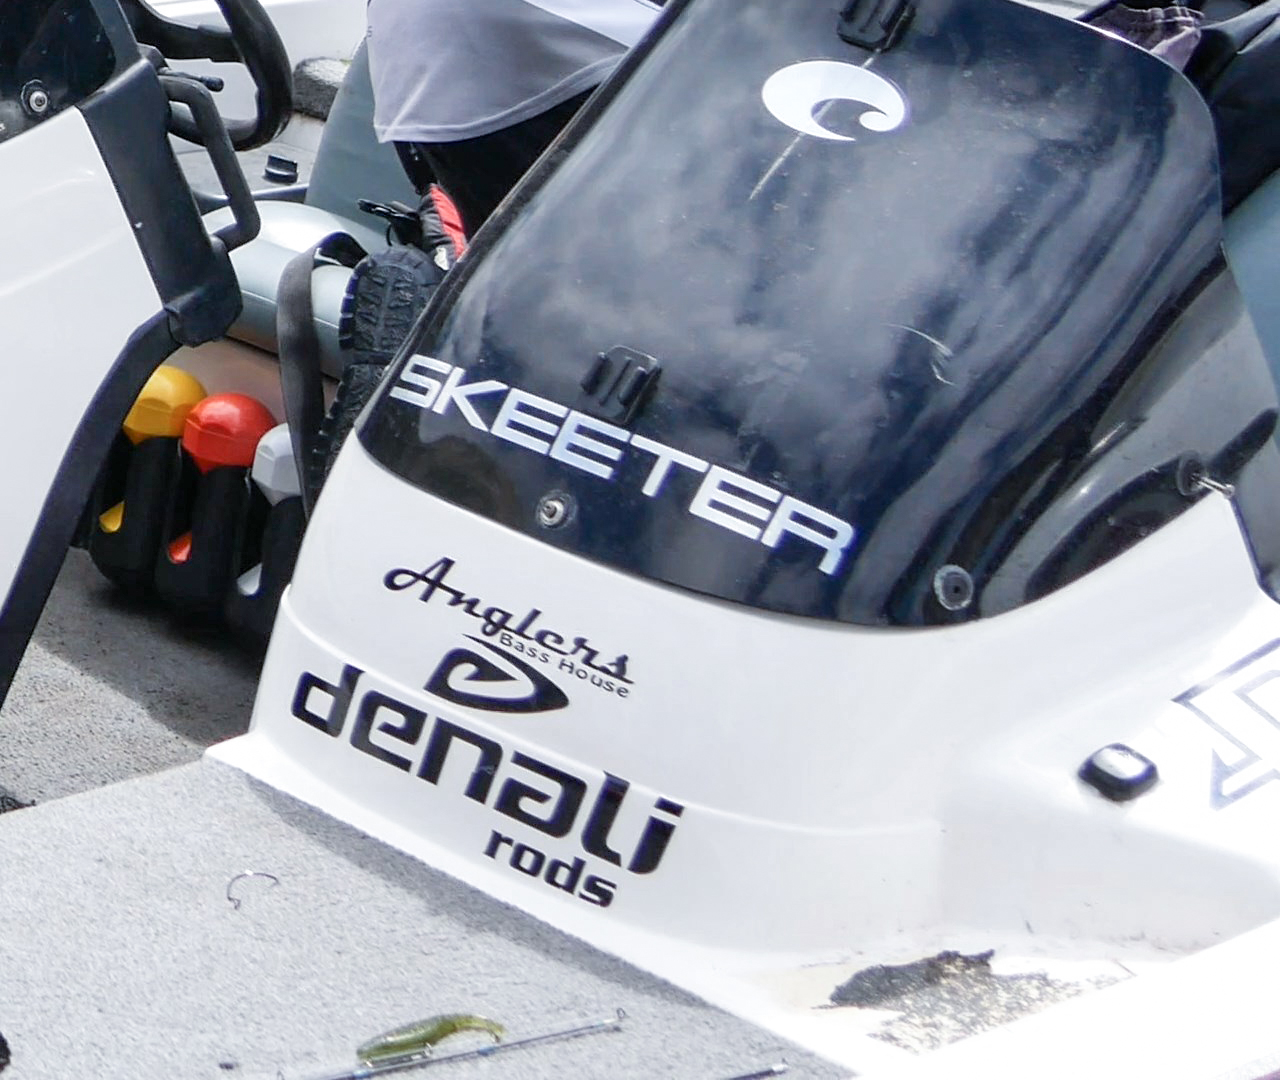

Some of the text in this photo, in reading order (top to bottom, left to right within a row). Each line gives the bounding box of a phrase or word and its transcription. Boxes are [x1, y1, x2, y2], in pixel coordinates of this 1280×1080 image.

[389, 352, 856, 575] SKEETER
[383, 557, 636, 685] Anglers
[498, 631, 631, 700] Bass House
[291, 664, 685, 876] denali
[483, 828, 618, 910] rods
